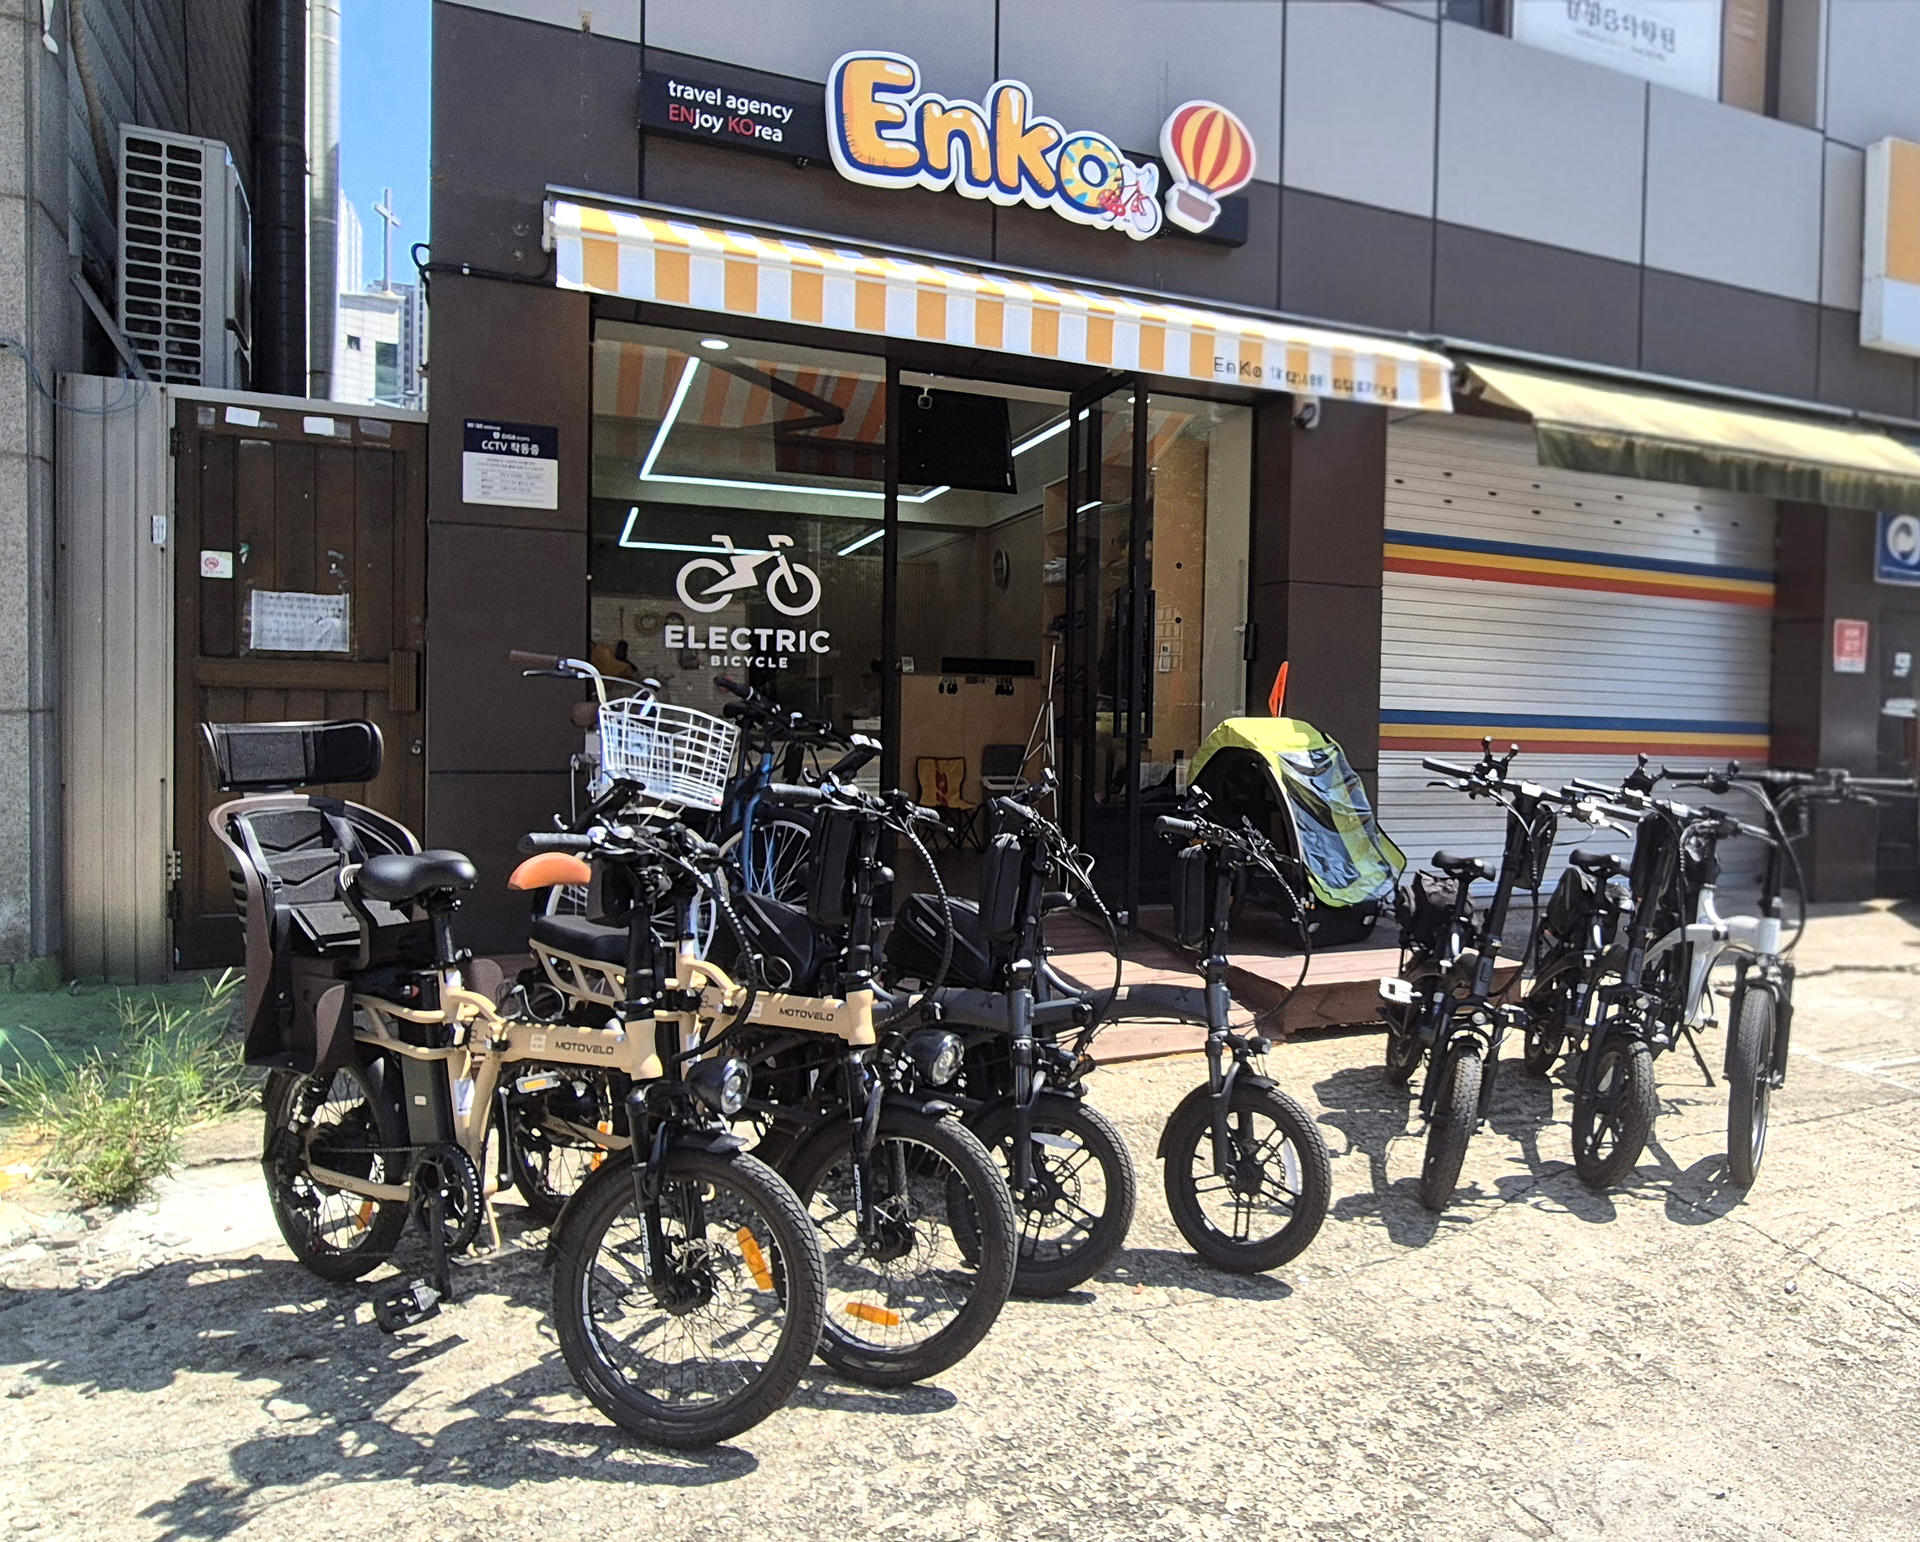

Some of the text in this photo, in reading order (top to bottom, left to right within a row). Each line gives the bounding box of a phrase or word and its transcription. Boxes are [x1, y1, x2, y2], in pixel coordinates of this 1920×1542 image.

[667, 80, 793, 124] travel agency
[669, 104, 783, 142] ENjoy KOrea
[481, 440, 508, 452] CCTV
[664, 625, 831, 654] ELECTRIC
[710, 655, 788, 669] BICYCLE
[779, 1007, 834, 1022] MOTOVELO
[554, 1041, 614, 1056] MOTOVELO
